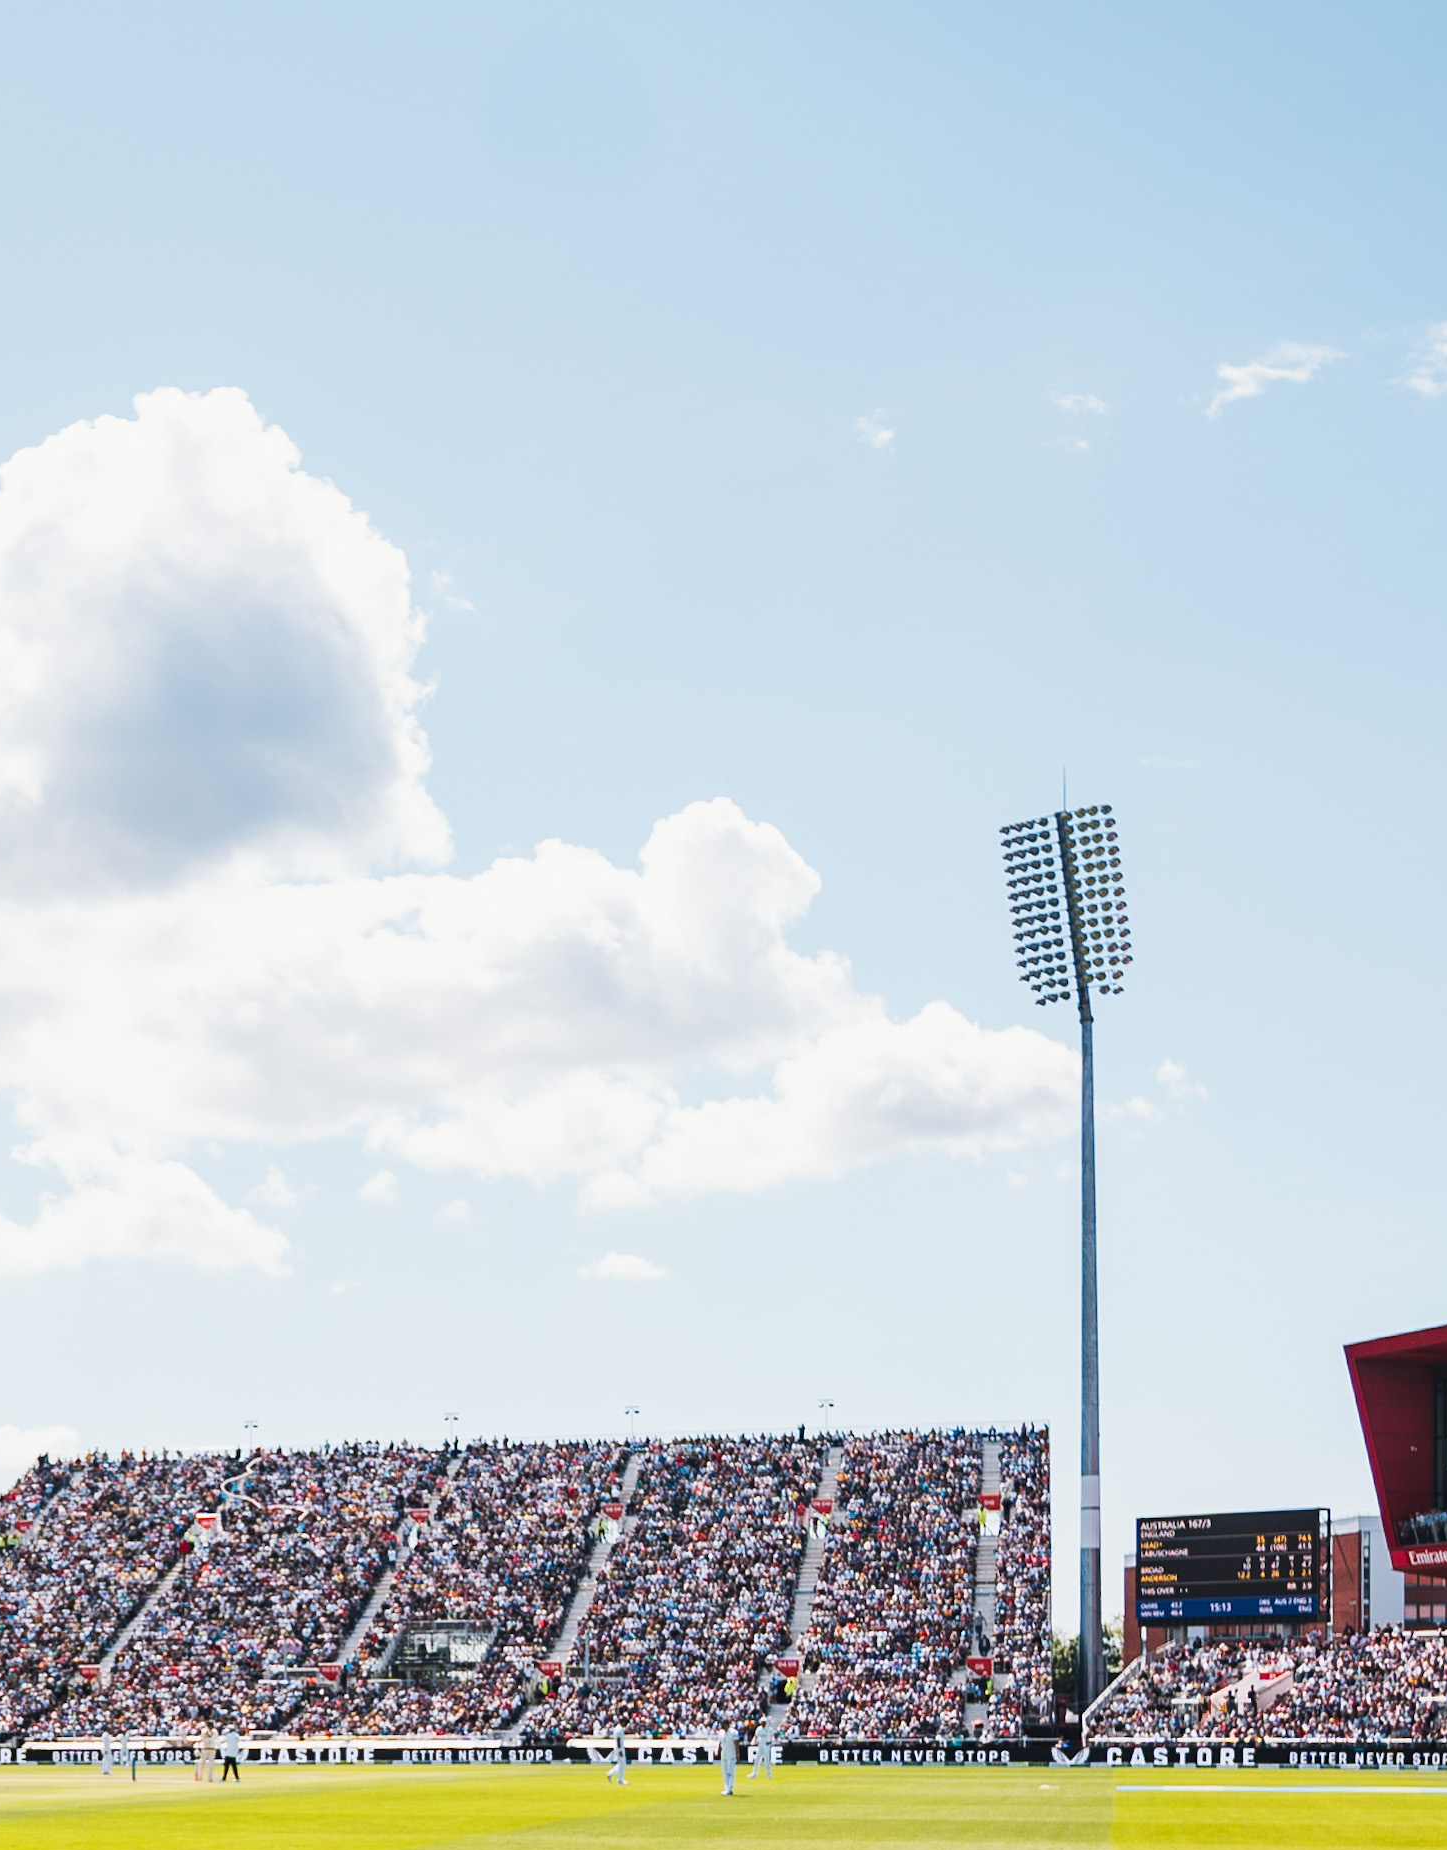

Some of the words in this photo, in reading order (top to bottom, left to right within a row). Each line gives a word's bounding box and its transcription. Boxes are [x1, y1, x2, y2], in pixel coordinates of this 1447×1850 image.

[1140, 1521, 1185, 1531] AUSTRALIA
[1188, 1519, 1212, 1530] 167/3
[1140, 1530, 1176, 1538] ENGLAND
[1209, 1601, 1232, 1613] 15:13
[52, 1750, 100, 1763] BETTER
[149, 1750, 193, 1763] STOPS
[259, 1747, 375, 1764] CASTORE
[402, 1749, 453, 1762] BETTER
[458, 1749, 504, 1762] NEVER
[508, 1749, 554, 1762] STOPS
[818, 1749, 883, 1763] BETTER
[890, 1749, 946, 1763] NEVER
[954, 1750, 1011, 1763] STOPS
[1106, 1747, 1256, 1767] CASTORE
[1288, 1751, 1348, 1766] BETTER
[1354, 1752, 1406, 1766] NEVER
